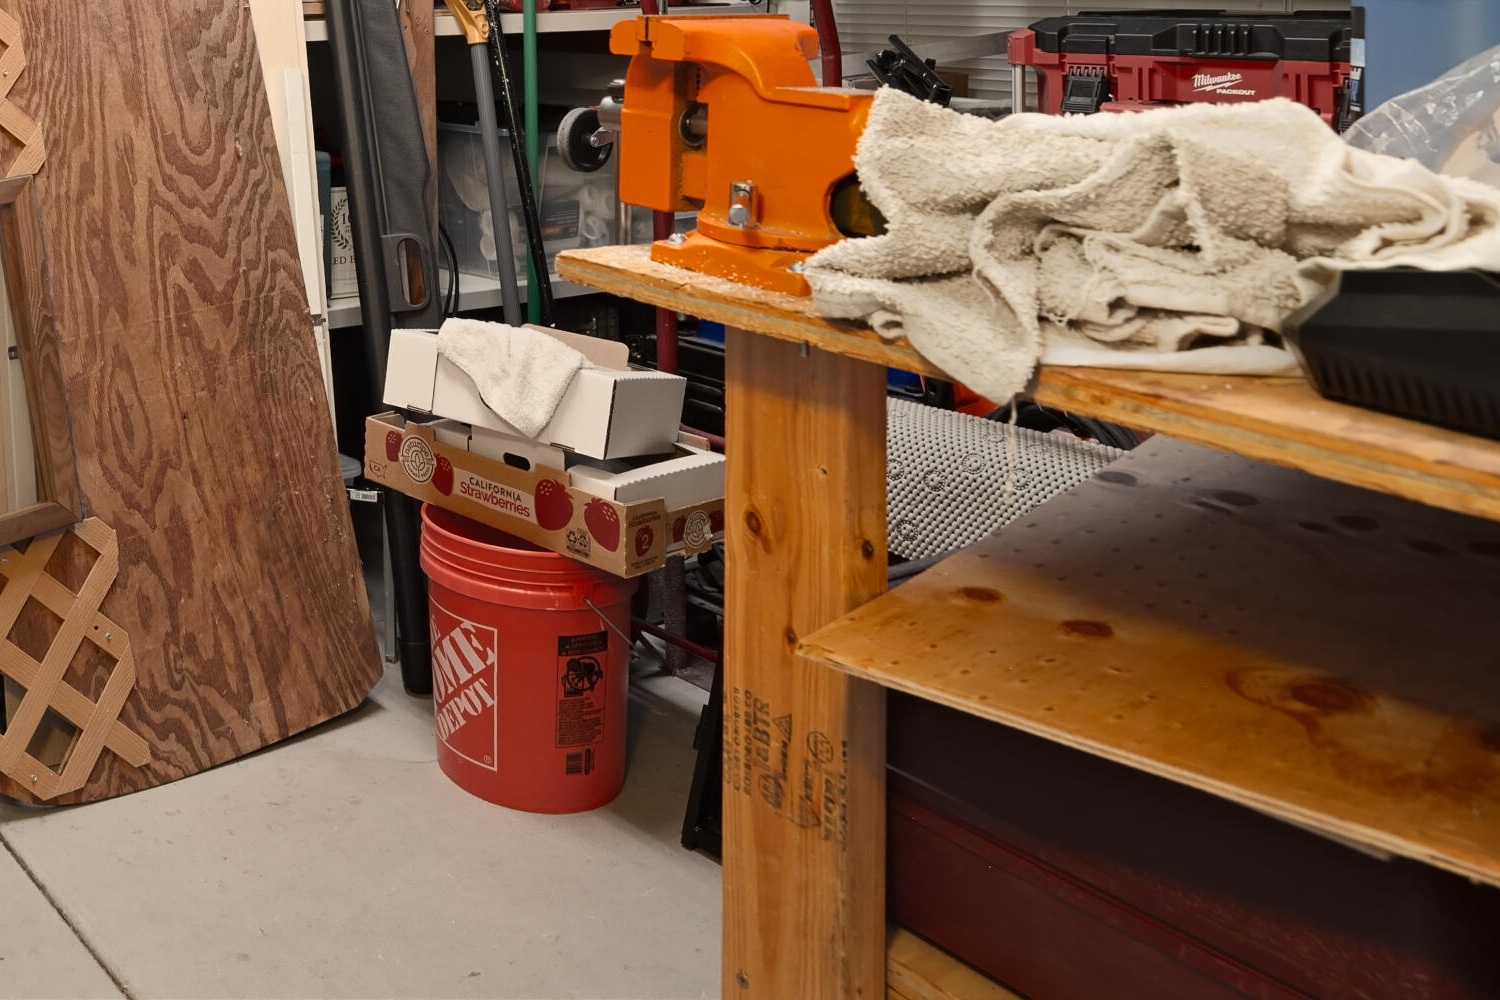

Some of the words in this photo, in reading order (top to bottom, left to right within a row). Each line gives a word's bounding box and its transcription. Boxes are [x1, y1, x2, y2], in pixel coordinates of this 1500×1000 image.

[1191, 72, 1242, 88] Milwaukee
[1216, 88, 1256, 96] PACKOUT
[460, 481, 530, 518] Strawberries
[469, 476, 522, 502] CALIFORNIA
[641, 533, 649, 549] 2
[432, 621, 495, 704] OME
[437, 677, 495, 741] DEPOT
